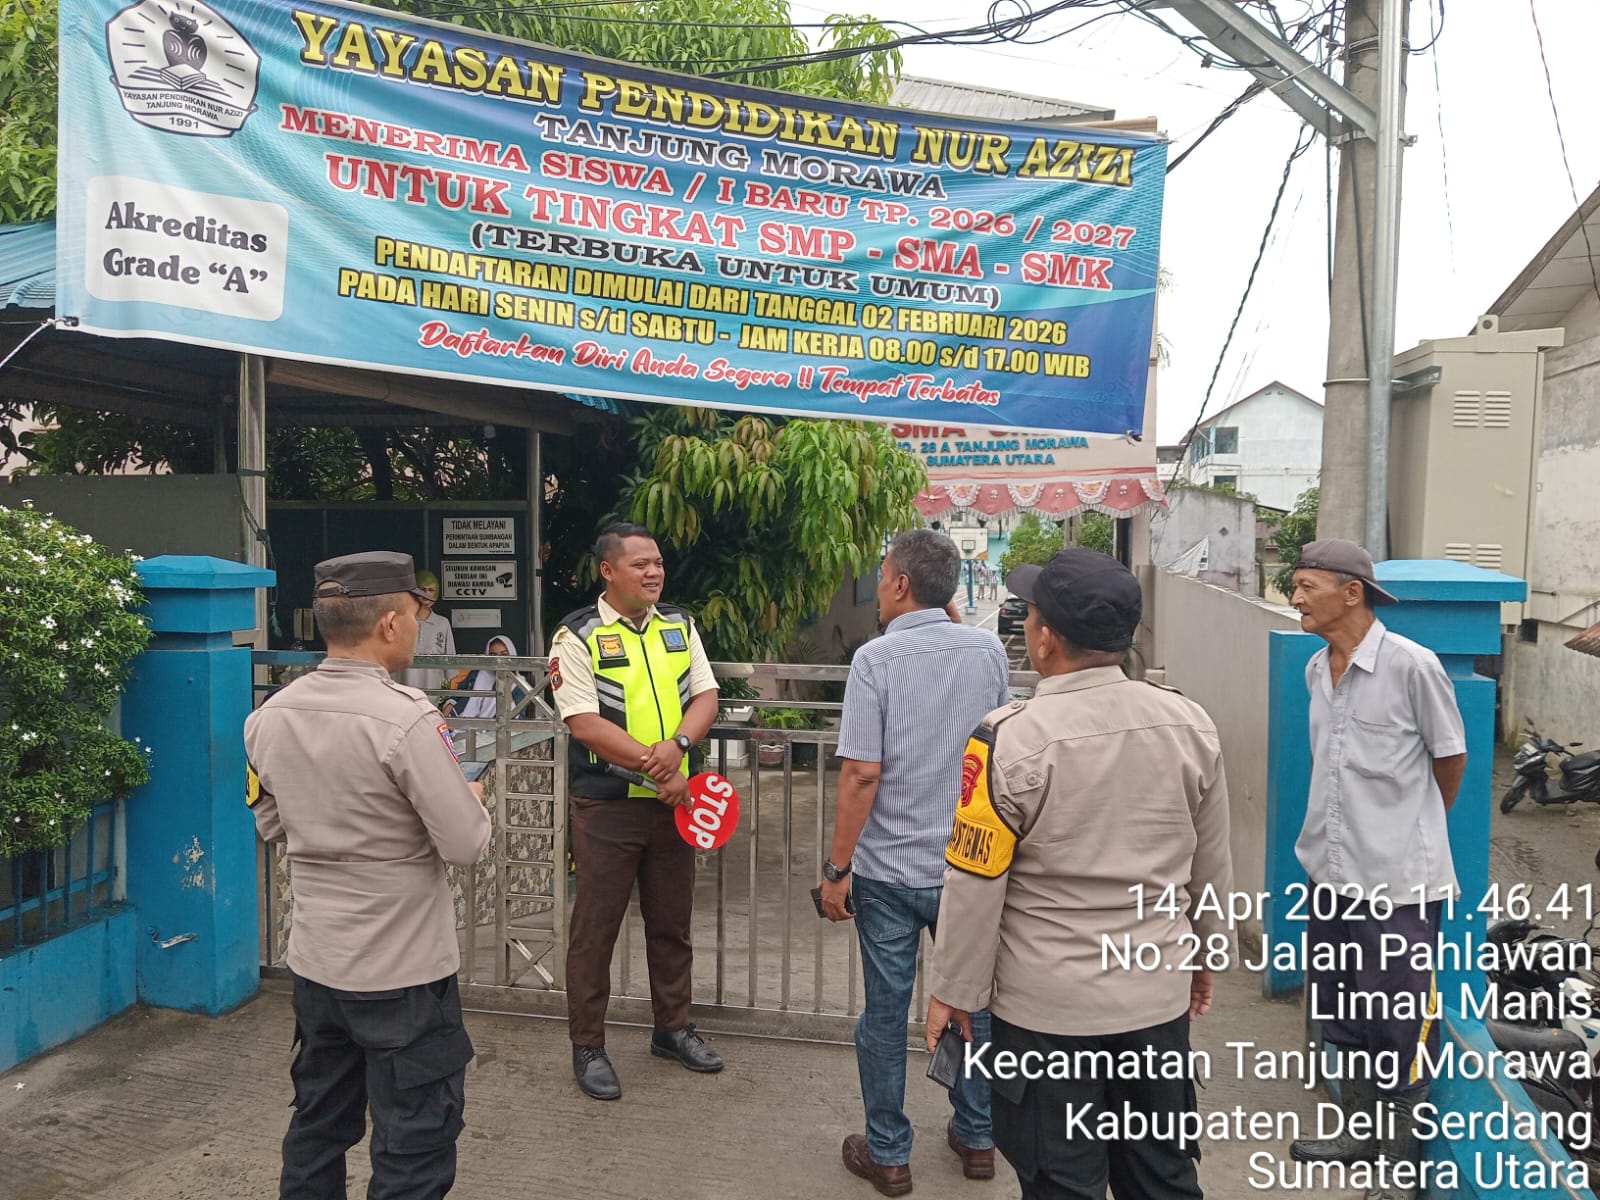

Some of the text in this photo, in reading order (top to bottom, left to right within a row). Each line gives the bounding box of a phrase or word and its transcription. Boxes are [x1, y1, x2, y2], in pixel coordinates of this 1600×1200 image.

[122, 90, 244, 118] YAYASAN PENDIDIKAN NUR AZIZI
[146, 101, 220, 122] TANJUNG MORAWA
[168, 117, 200, 129] 1991
[293, 10, 1135, 187] YAYASAN PENDIDIKAN NUR AZIZI
[280, 105, 1135, 247] MENERIMA SISWA / I BARU TP. 2026 / 2027
[536, 114, 946, 199] TANJUNG MORAWA
[105, 201, 268, 253] Akreditas
[325, 154, 1112, 290] UNTUK TINGKAT SMP - SMA - SMK
[103, 247, 201, 285] Grade
[375, 236, 1068, 345] PENDAFTARAN DIMULAI DARI TANGGAL 02 FEBRUARI 2026
[471, 223, 1001, 310] (TERBUKA UNTUK UMUM)
[338, 267, 417, 307] PADA
[420, 280, 490, 316] HARI
[494, 291, 575, 328] SENIN
[578, 306, 627, 335] s/d
[630, 310, 717, 345] SABTU
[738, 324, 789, 353] JAM
[792, 329, 866, 360] KERJA
[867, 336, 936, 366] 08.00
[938, 343, 981, 370] s/d
[983, 347, 1040, 375] 17.00
[1042, 352, 1091, 378] WIB
[420, 321, 1000, 405] Daftarkan Diri Anda Segera !! Tempat Terbatas
[897, 441, 916, 453] O.
[940, 441, 951, 453] A
[955, 440, 1020, 453] TANJUNG
[1025, 437, 1089, 450] MORAWA
[926, 453, 1056, 467] SUMATERA UTARA
[451, 520, 506, 530] TIDAK MELAYANI
[456, 588, 487, 596] CCTV
[687, 775, 734, 849] STOP
